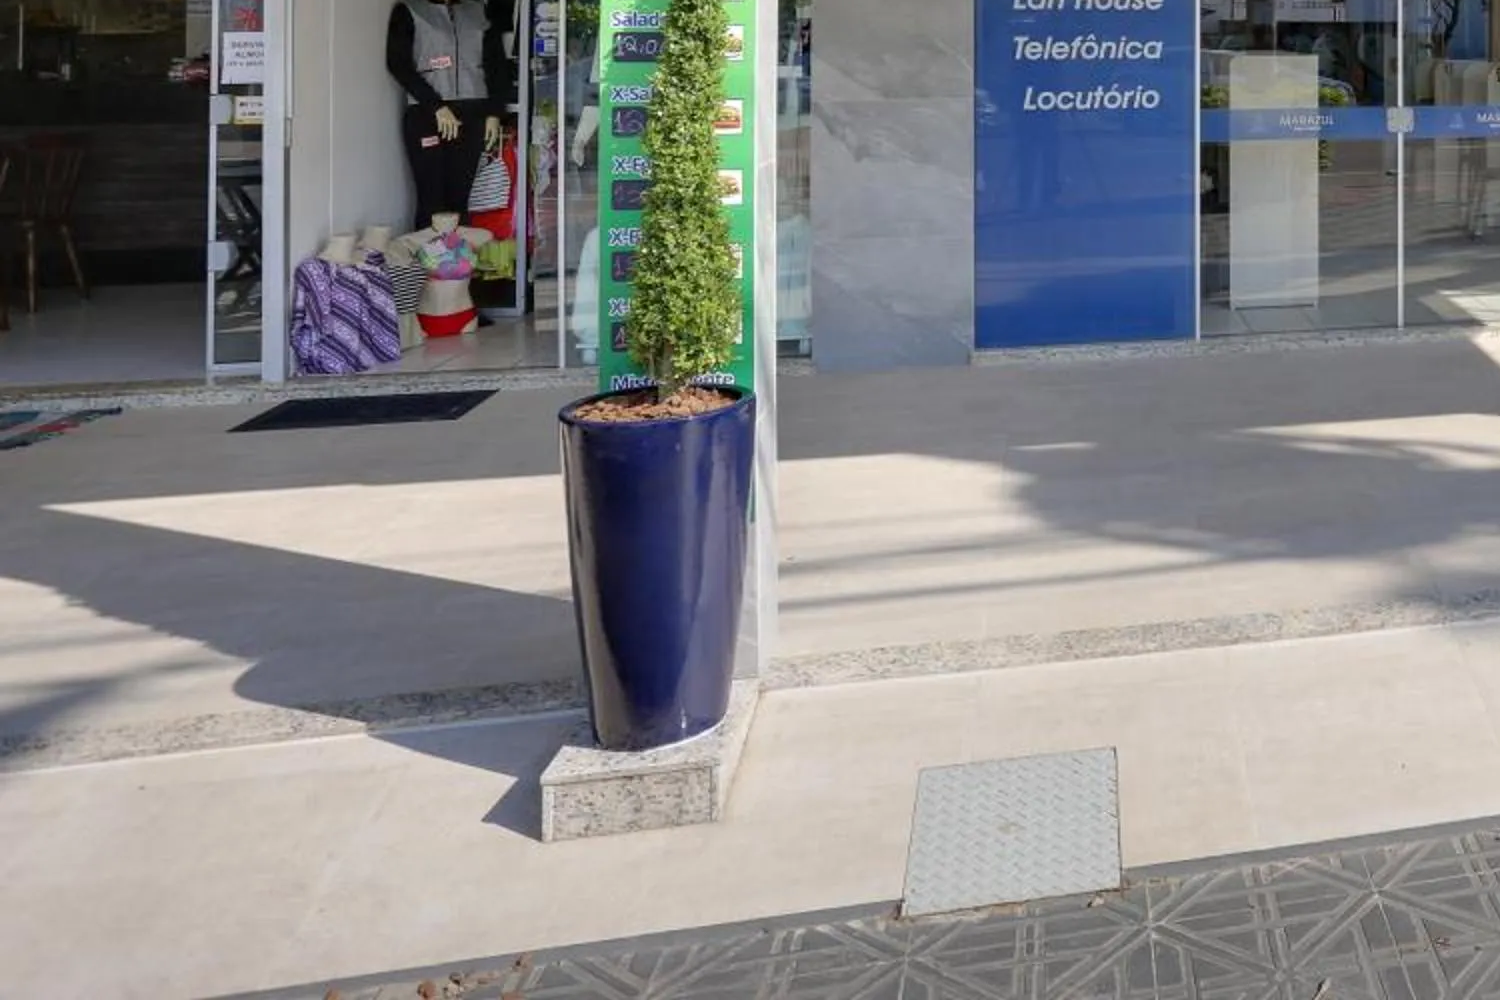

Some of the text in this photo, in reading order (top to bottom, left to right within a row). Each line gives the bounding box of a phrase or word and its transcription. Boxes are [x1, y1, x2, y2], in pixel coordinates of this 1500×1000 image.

[611, 10, 661, 27] Salad
[1013, 33, 1164, 61] Telefônica
[1023, 82, 1162, 111] Locutório
